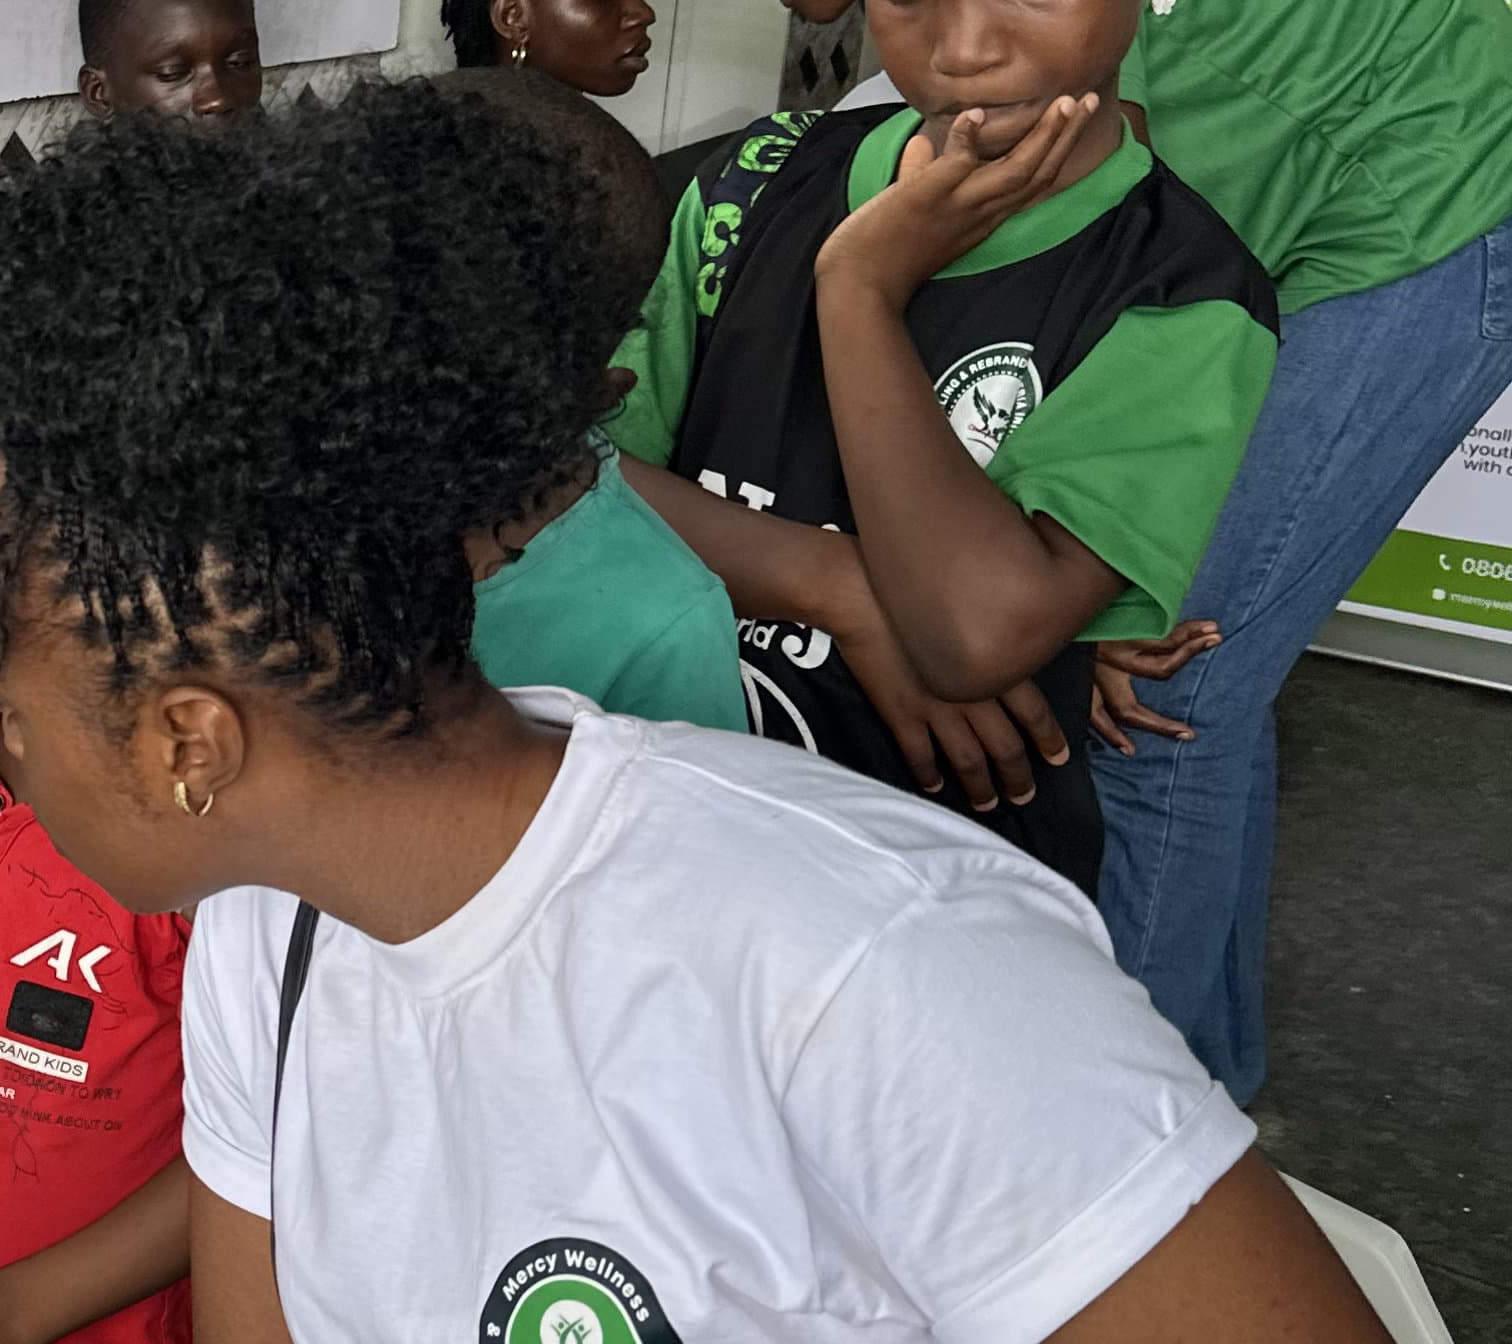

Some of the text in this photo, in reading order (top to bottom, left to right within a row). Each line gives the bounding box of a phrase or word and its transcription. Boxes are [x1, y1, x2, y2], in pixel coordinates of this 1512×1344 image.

[939, 356, 1027, 405] LING & REBRAND
[1464, 457, 1502, 475] with
[45, 1057, 83, 1077] KIDS
[502, 1249, 649, 1322] Mercy Wellness
[487, 1322, 501, 1337] &
